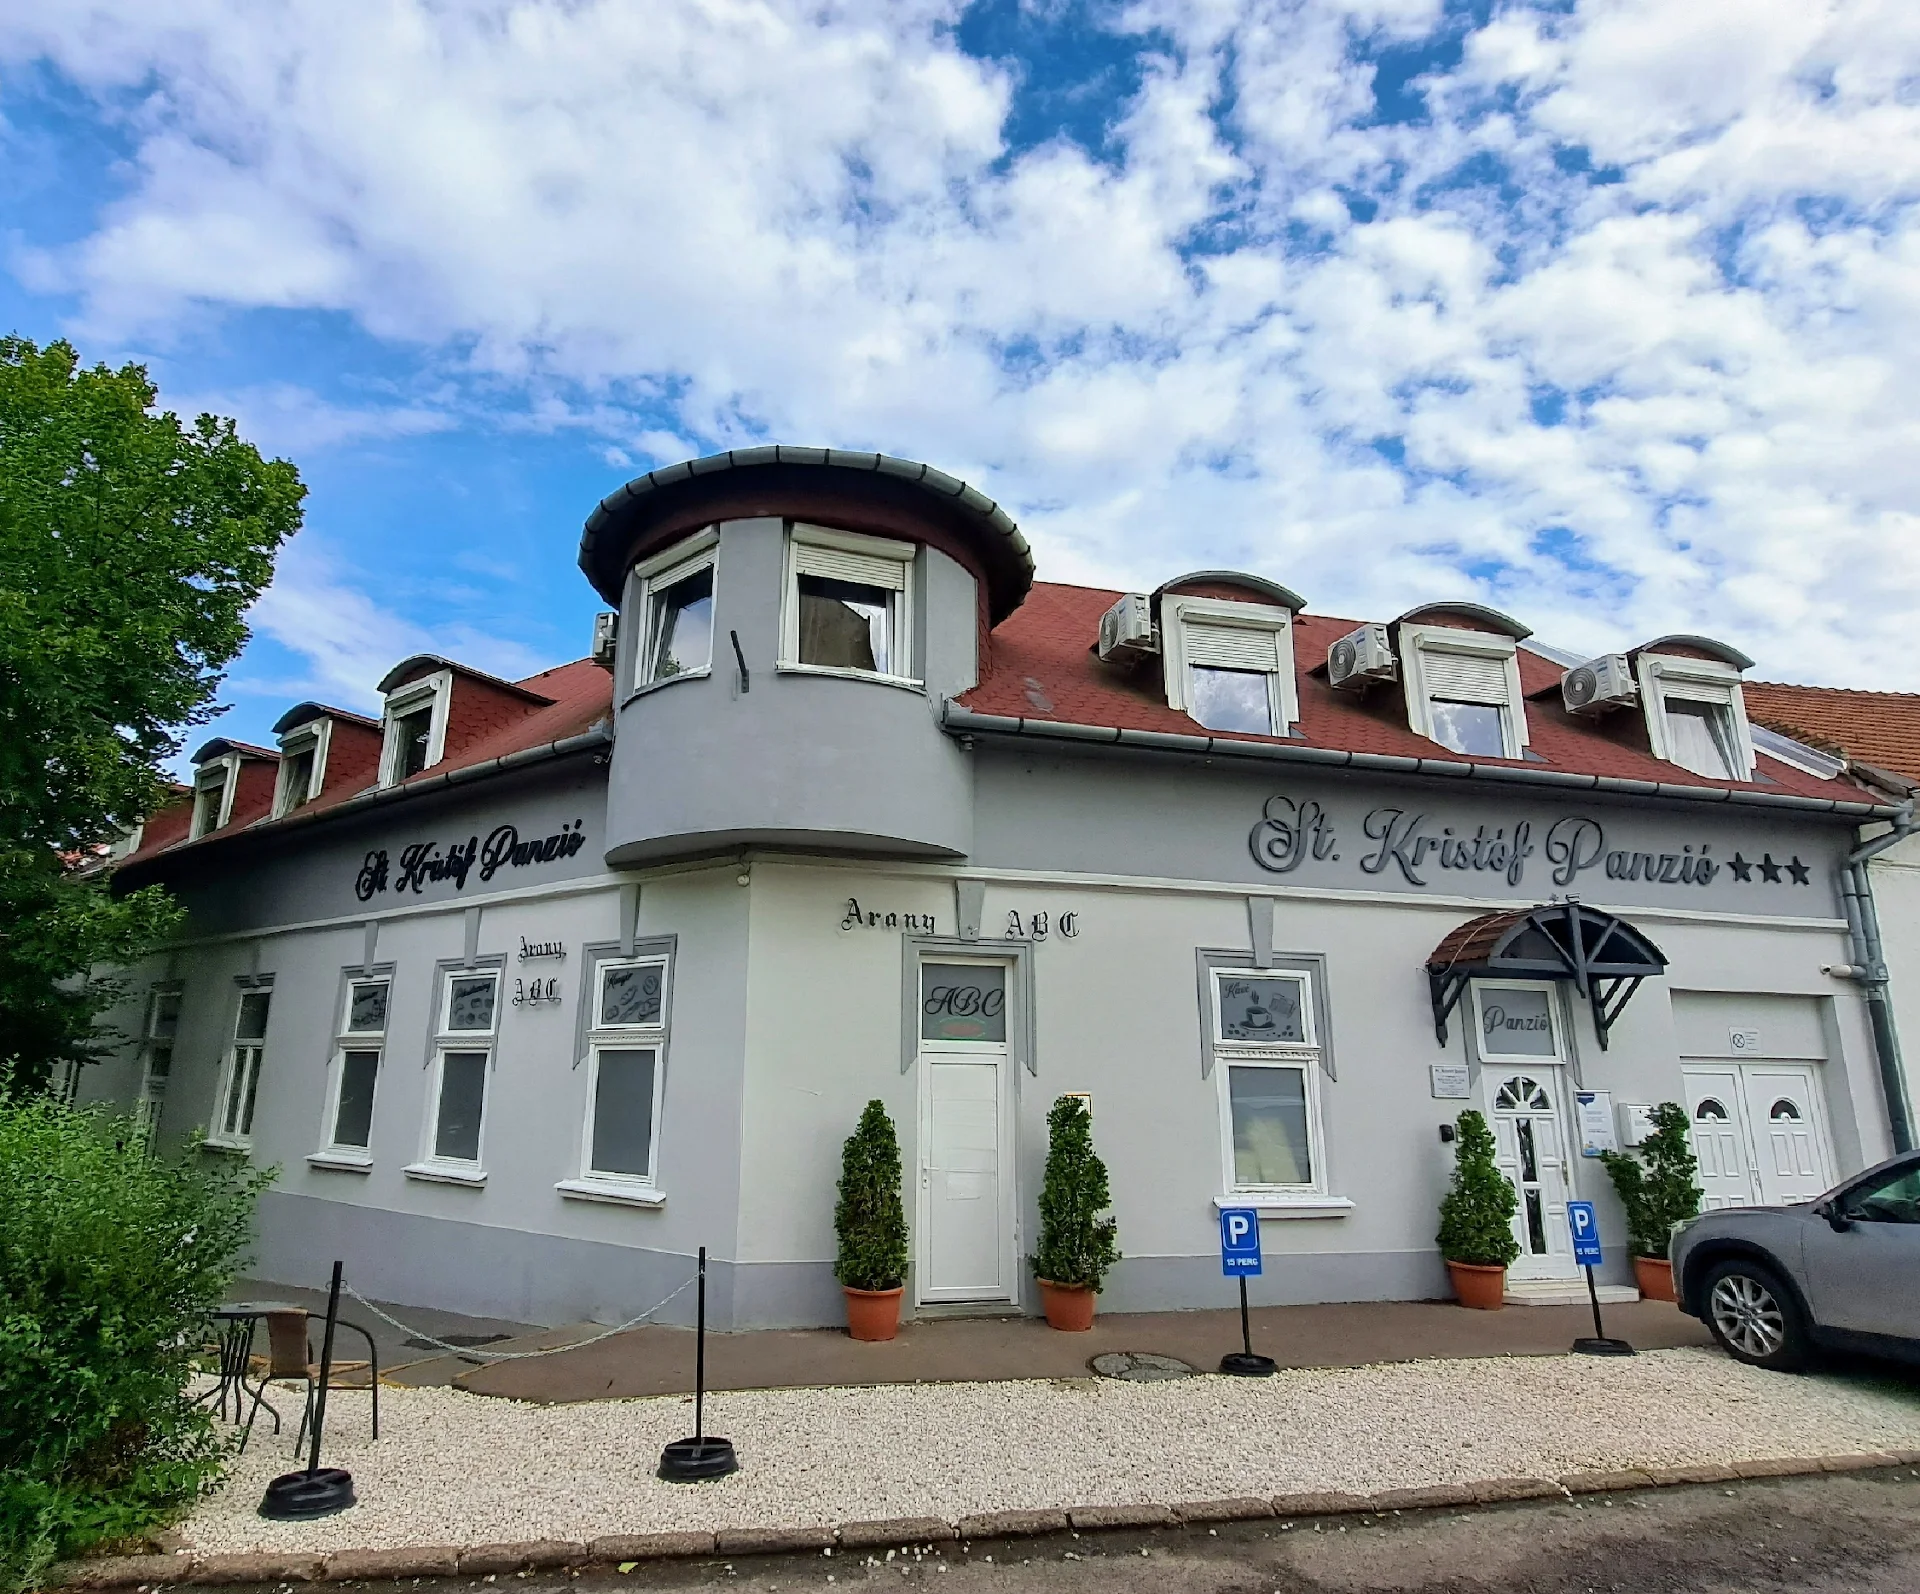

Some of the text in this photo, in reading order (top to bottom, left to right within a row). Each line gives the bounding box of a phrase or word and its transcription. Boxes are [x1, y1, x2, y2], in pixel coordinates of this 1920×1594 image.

[396, 836, 479, 894] Kristóf
[480, 818, 587, 882] Panzió
[1248, 795, 1721, 887] St. Kristóf Panzió
[841, 897, 1081, 942] Arany ABC
[518, 935, 563, 963] Arany
[512, 978, 560, 1006] ABC
[924, 986, 1005, 1017] ABC
[1483, 1005, 1548, 1034] Panzió
[1228, 1215, 1249, 1246] P
[1574, 1209, 1589, 1236] P
[1226, 1257, 1235, 1267] 15
